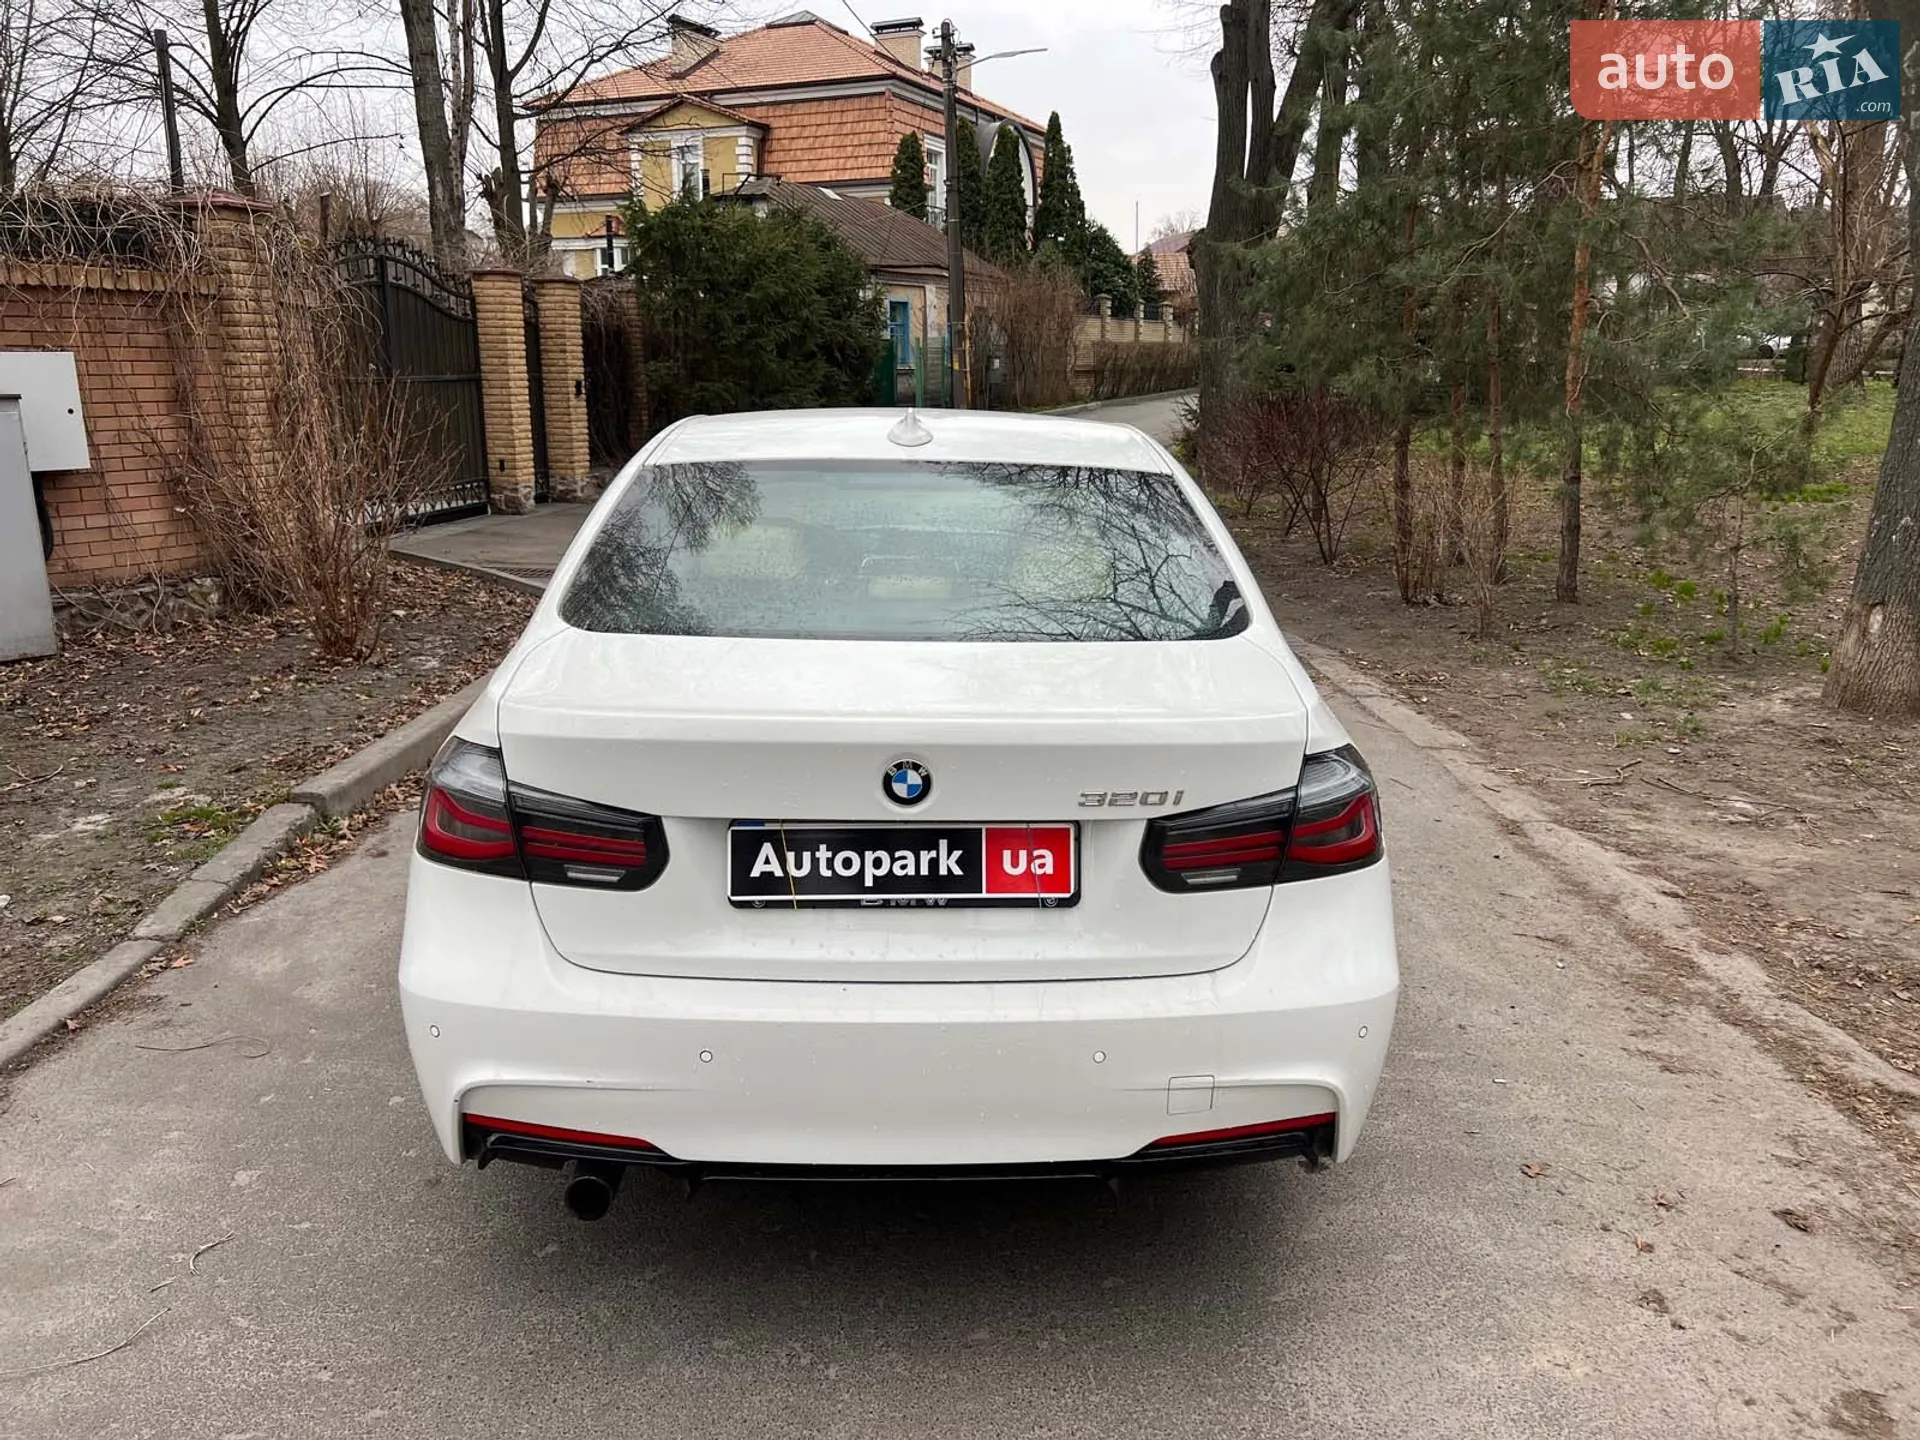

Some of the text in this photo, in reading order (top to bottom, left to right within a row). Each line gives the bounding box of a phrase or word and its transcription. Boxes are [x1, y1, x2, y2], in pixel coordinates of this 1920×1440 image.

[886, 760, 929, 777] BMW
[1078, 790, 1184, 807] 320i
[749, 839, 1055, 887] Autopark ua
